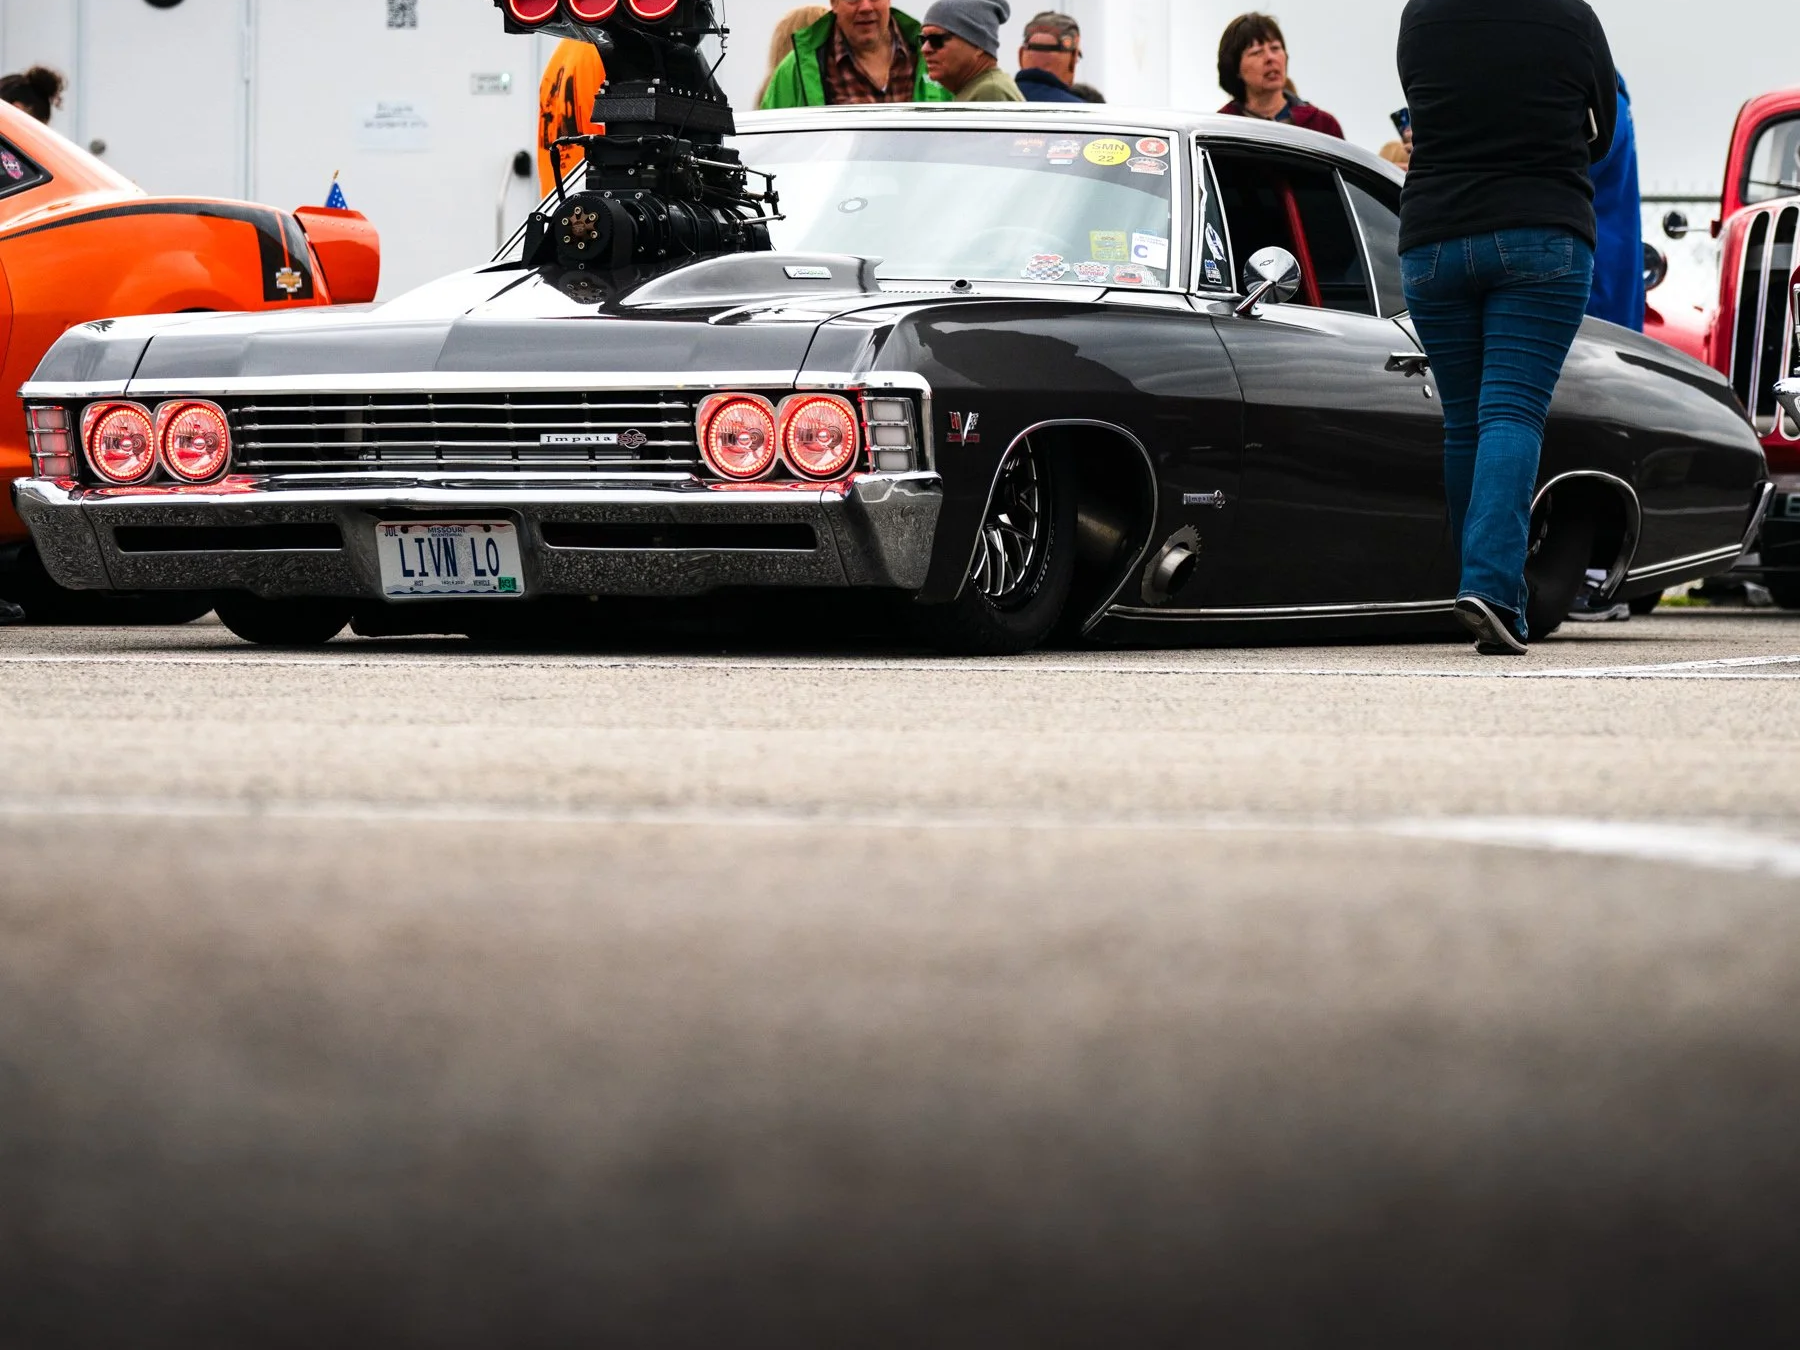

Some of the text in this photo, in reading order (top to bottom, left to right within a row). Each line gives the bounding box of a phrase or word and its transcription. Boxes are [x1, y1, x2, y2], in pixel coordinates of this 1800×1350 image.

[1092, 142, 1125, 151] SMN
[1133, 244, 1148, 258] C
[546, 435, 612, 443] Impala
[385, 526, 398, 537] JUL
[398, 537, 500, 577] LIVN LO
